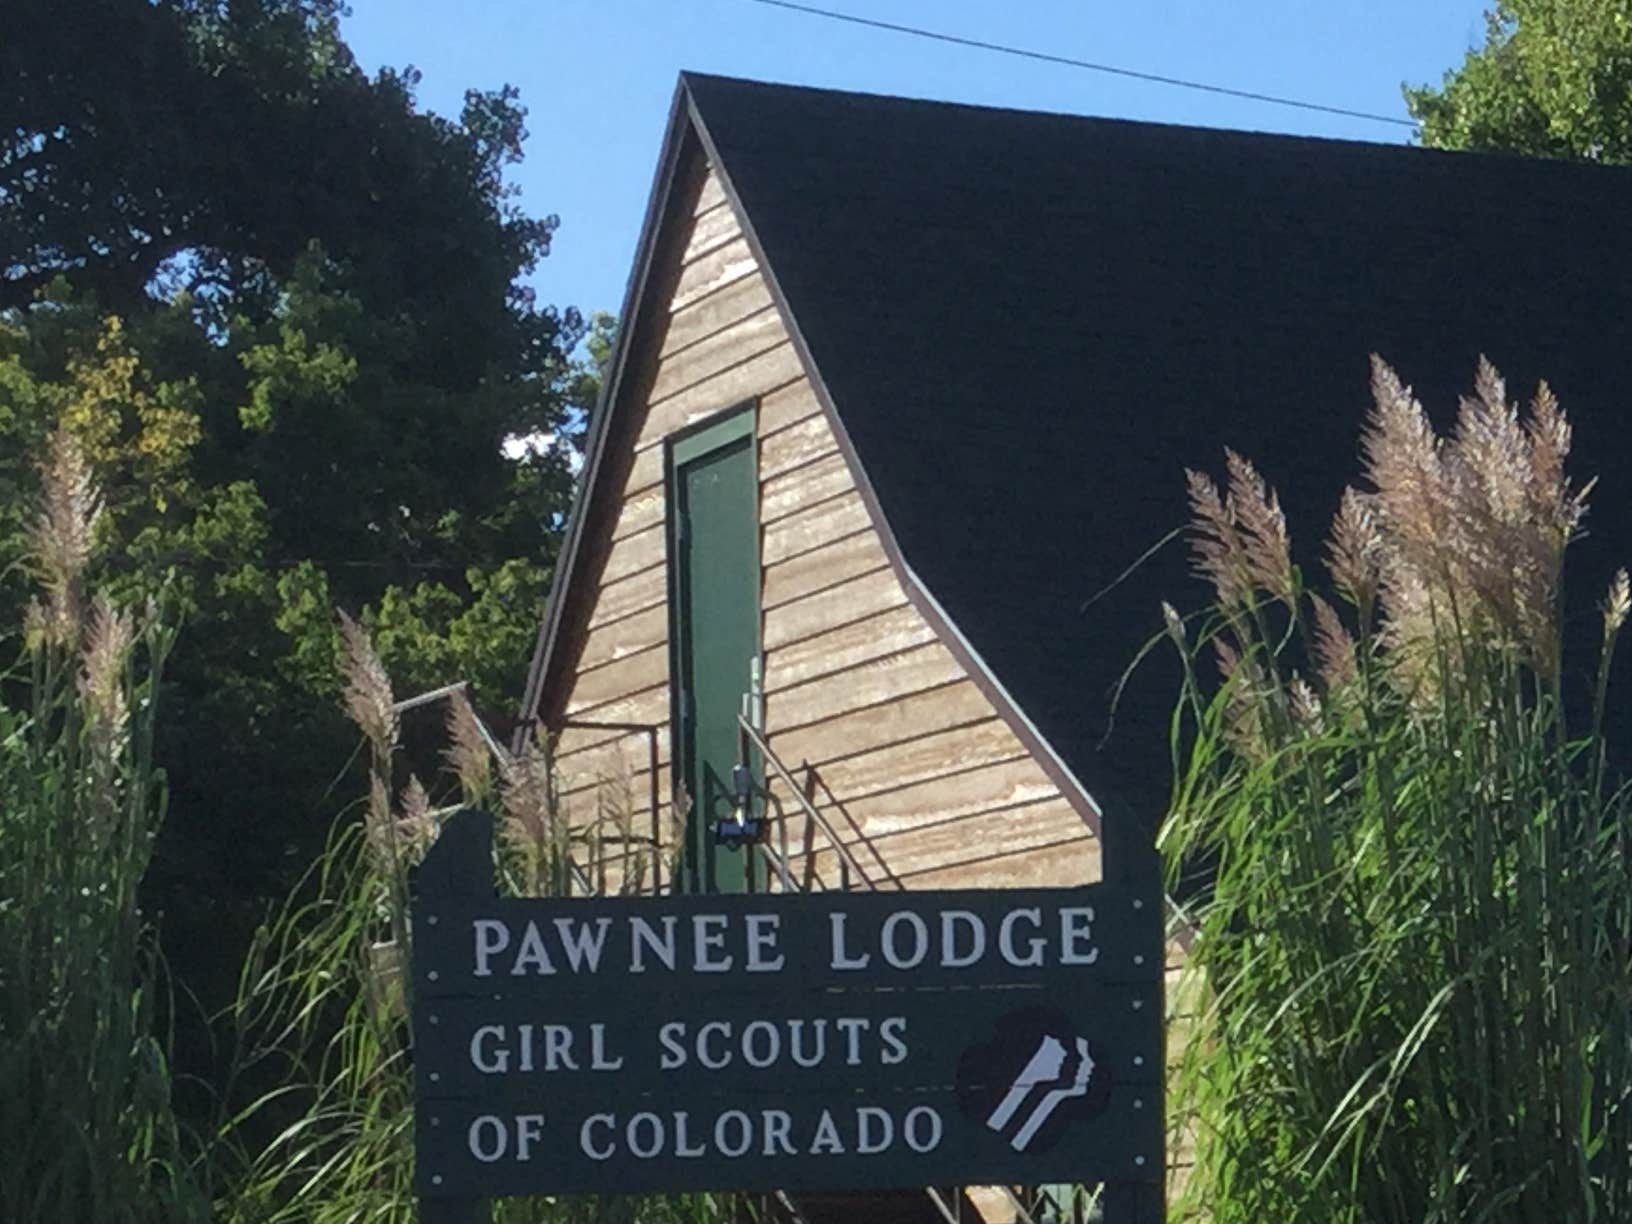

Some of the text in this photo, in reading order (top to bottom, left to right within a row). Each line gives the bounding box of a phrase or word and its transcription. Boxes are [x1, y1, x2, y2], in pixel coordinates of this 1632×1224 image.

[473, 907, 1099, 976] PAWNEE LODGE
[470, 1017, 907, 1073] GIRL SCOUTS
[469, 1106, 942, 1162] OF COLORADO
